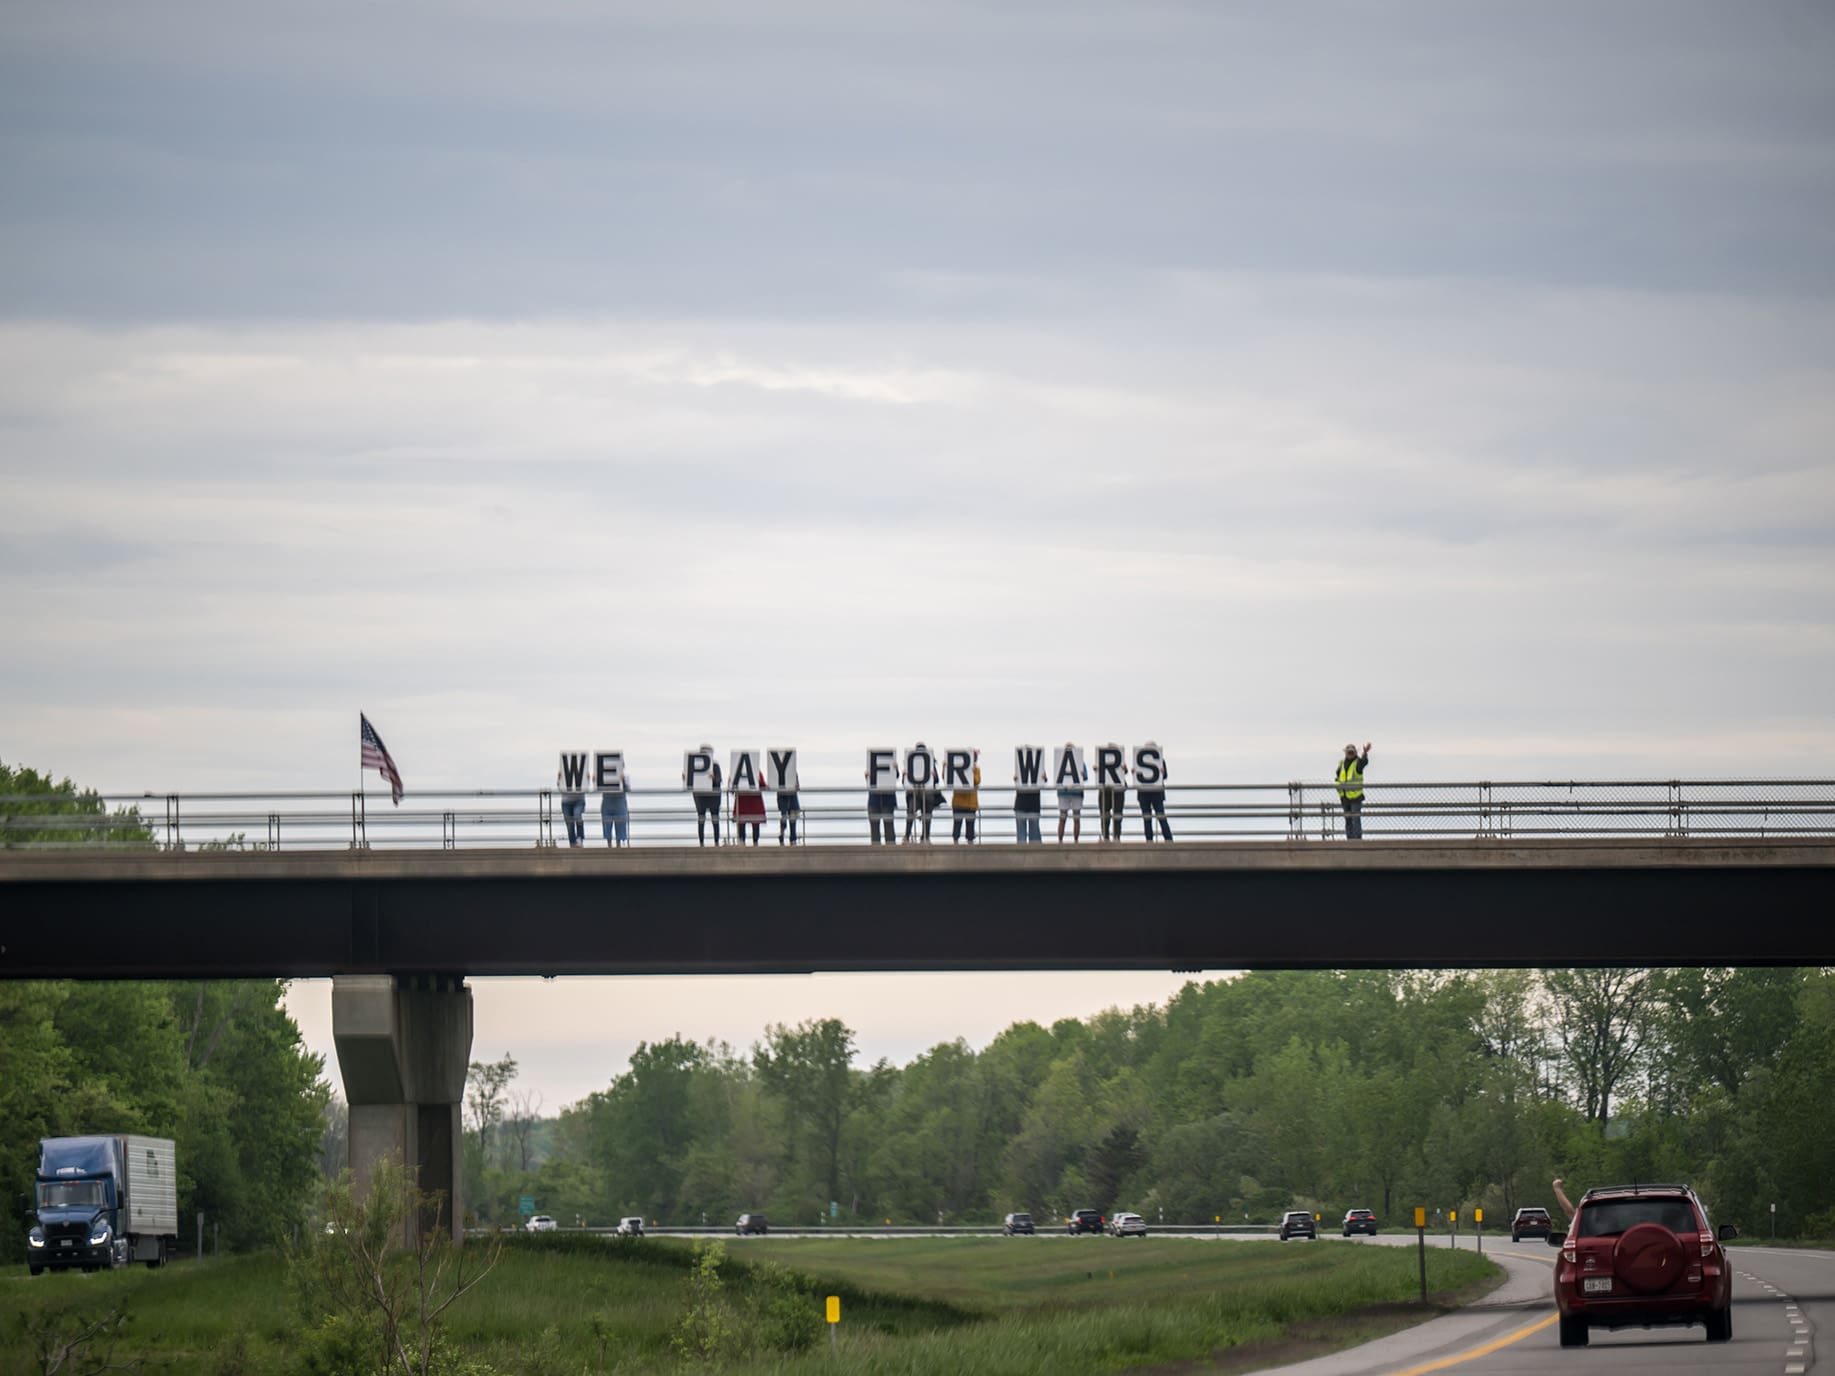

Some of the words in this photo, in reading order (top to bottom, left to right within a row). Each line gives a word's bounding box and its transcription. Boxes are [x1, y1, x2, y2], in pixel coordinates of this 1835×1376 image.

[562, 752, 621, 790] WE
[686, 751, 793, 790] PAY
[870, 751, 971, 786] FOR
[1017, 750, 1161, 786] WARS
